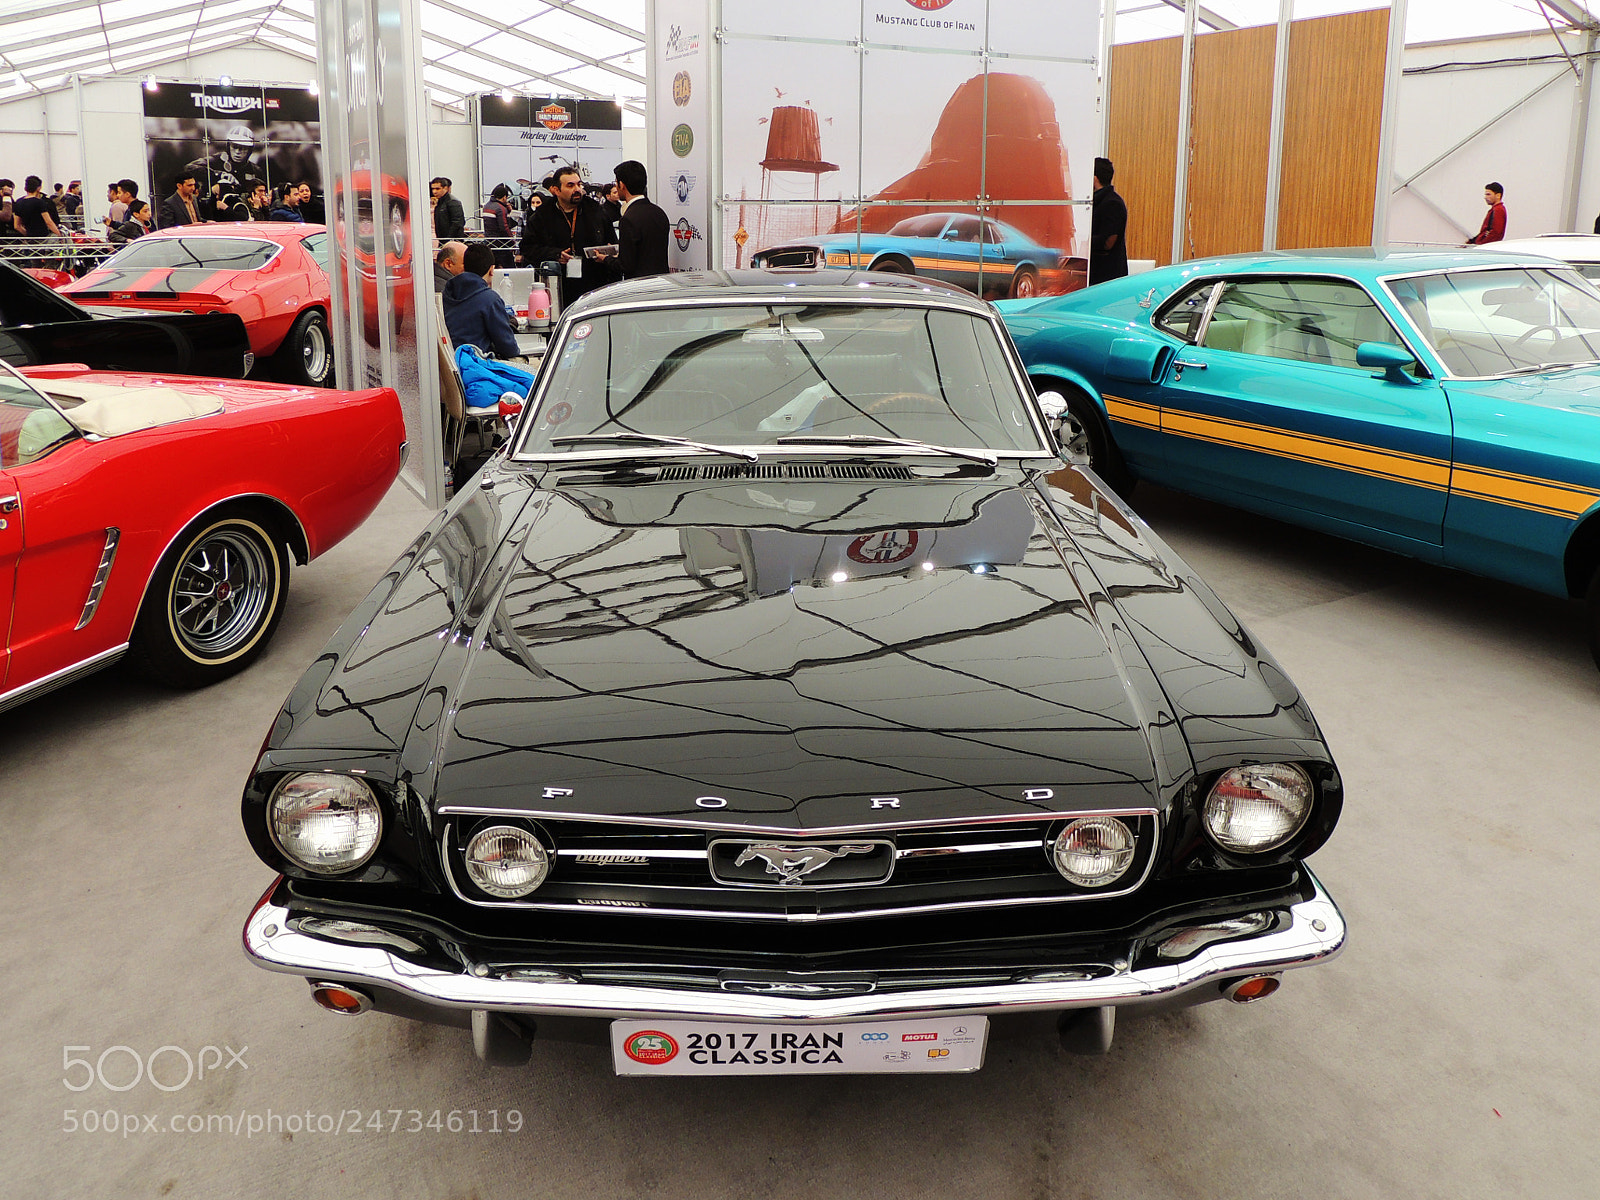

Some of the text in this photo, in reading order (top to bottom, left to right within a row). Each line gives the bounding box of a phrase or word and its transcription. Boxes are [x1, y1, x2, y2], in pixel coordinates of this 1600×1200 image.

[875, 13, 976, 31] MUSTANG CLUB OF IRAN
[190, 92, 262, 114] TRIUMPH
[675, 134, 690, 146] FIVA
[637, 1037, 663, 1050] 25
[687, 1033, 758, 1049] 2017
[770, 1032, 843, 1049] IRAN
[688, 1050, 843, 1064] CLASSICA
